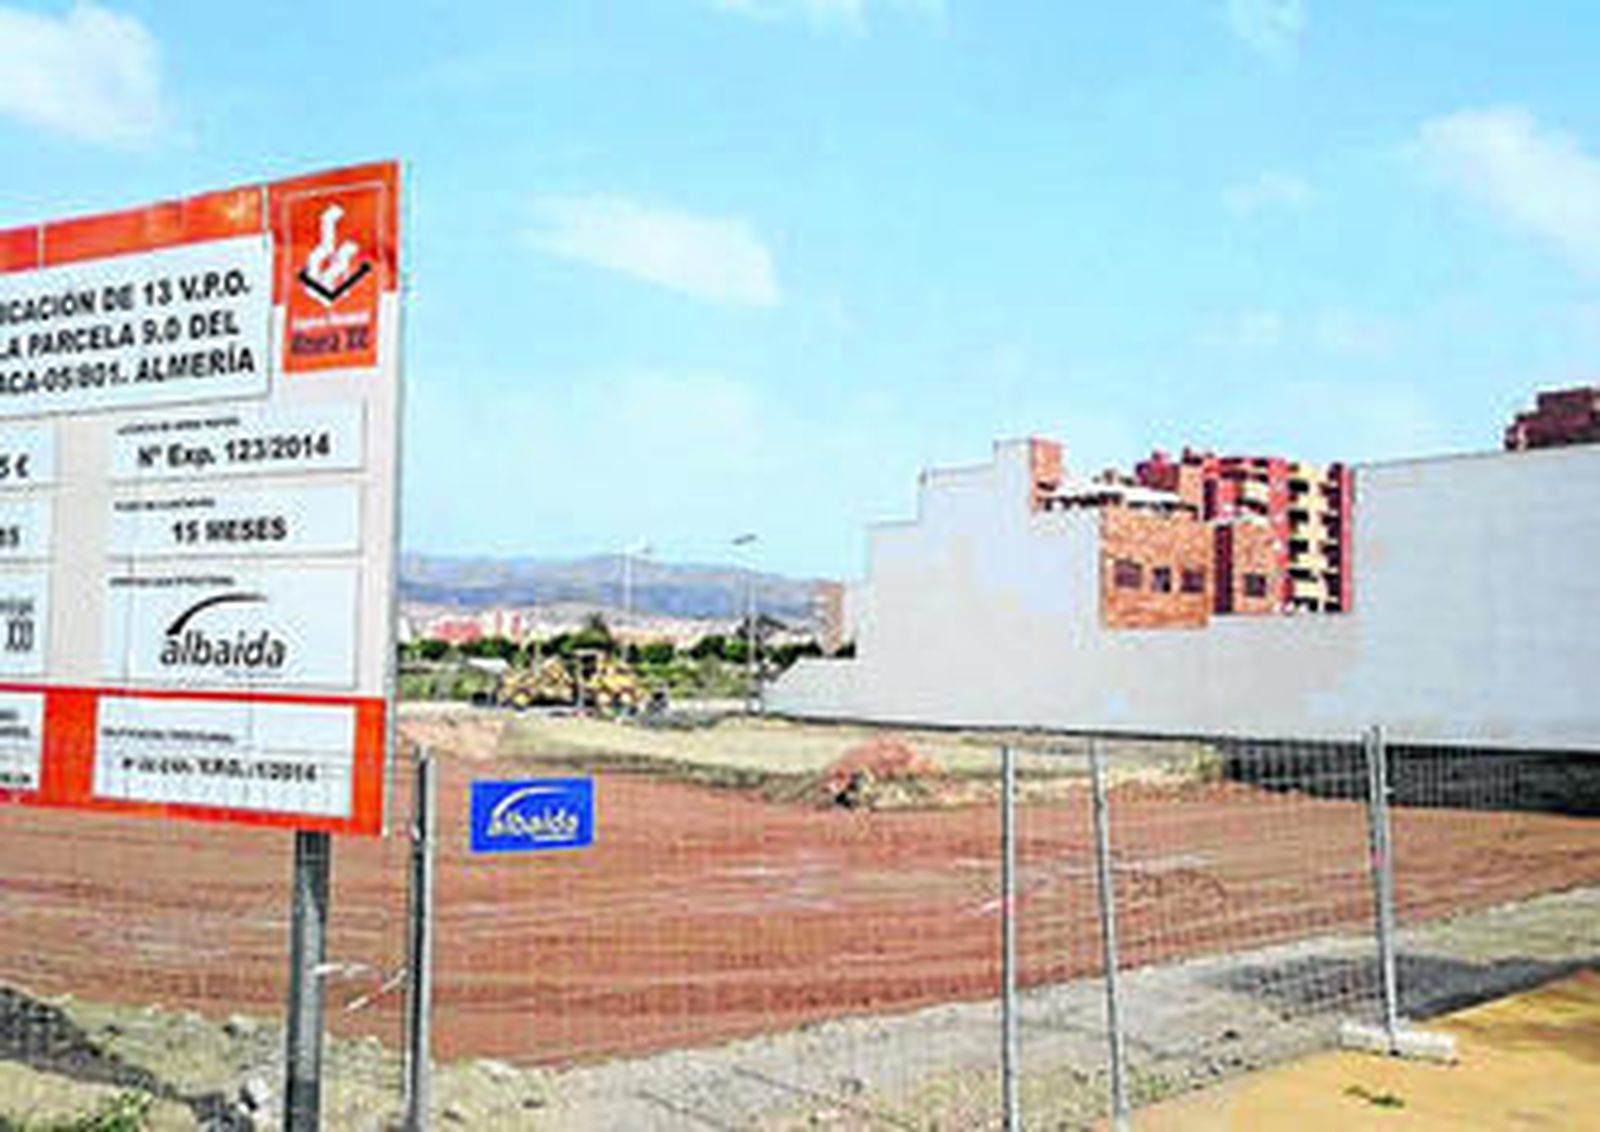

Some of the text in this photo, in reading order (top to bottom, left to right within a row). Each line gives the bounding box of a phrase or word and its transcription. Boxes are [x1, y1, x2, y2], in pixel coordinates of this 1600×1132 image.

[143, 278, 173, 306] 13
[179, 269, 252, 302] V.P.O.
[28, 323, 135, 358] PARCELA
[188, 310, 240, 340] DEL
[135, 342, 256, 383] ALMERÍA
[172, 516, 288, 545] 15 MESES
[160, 630, 287, 668] albaida
